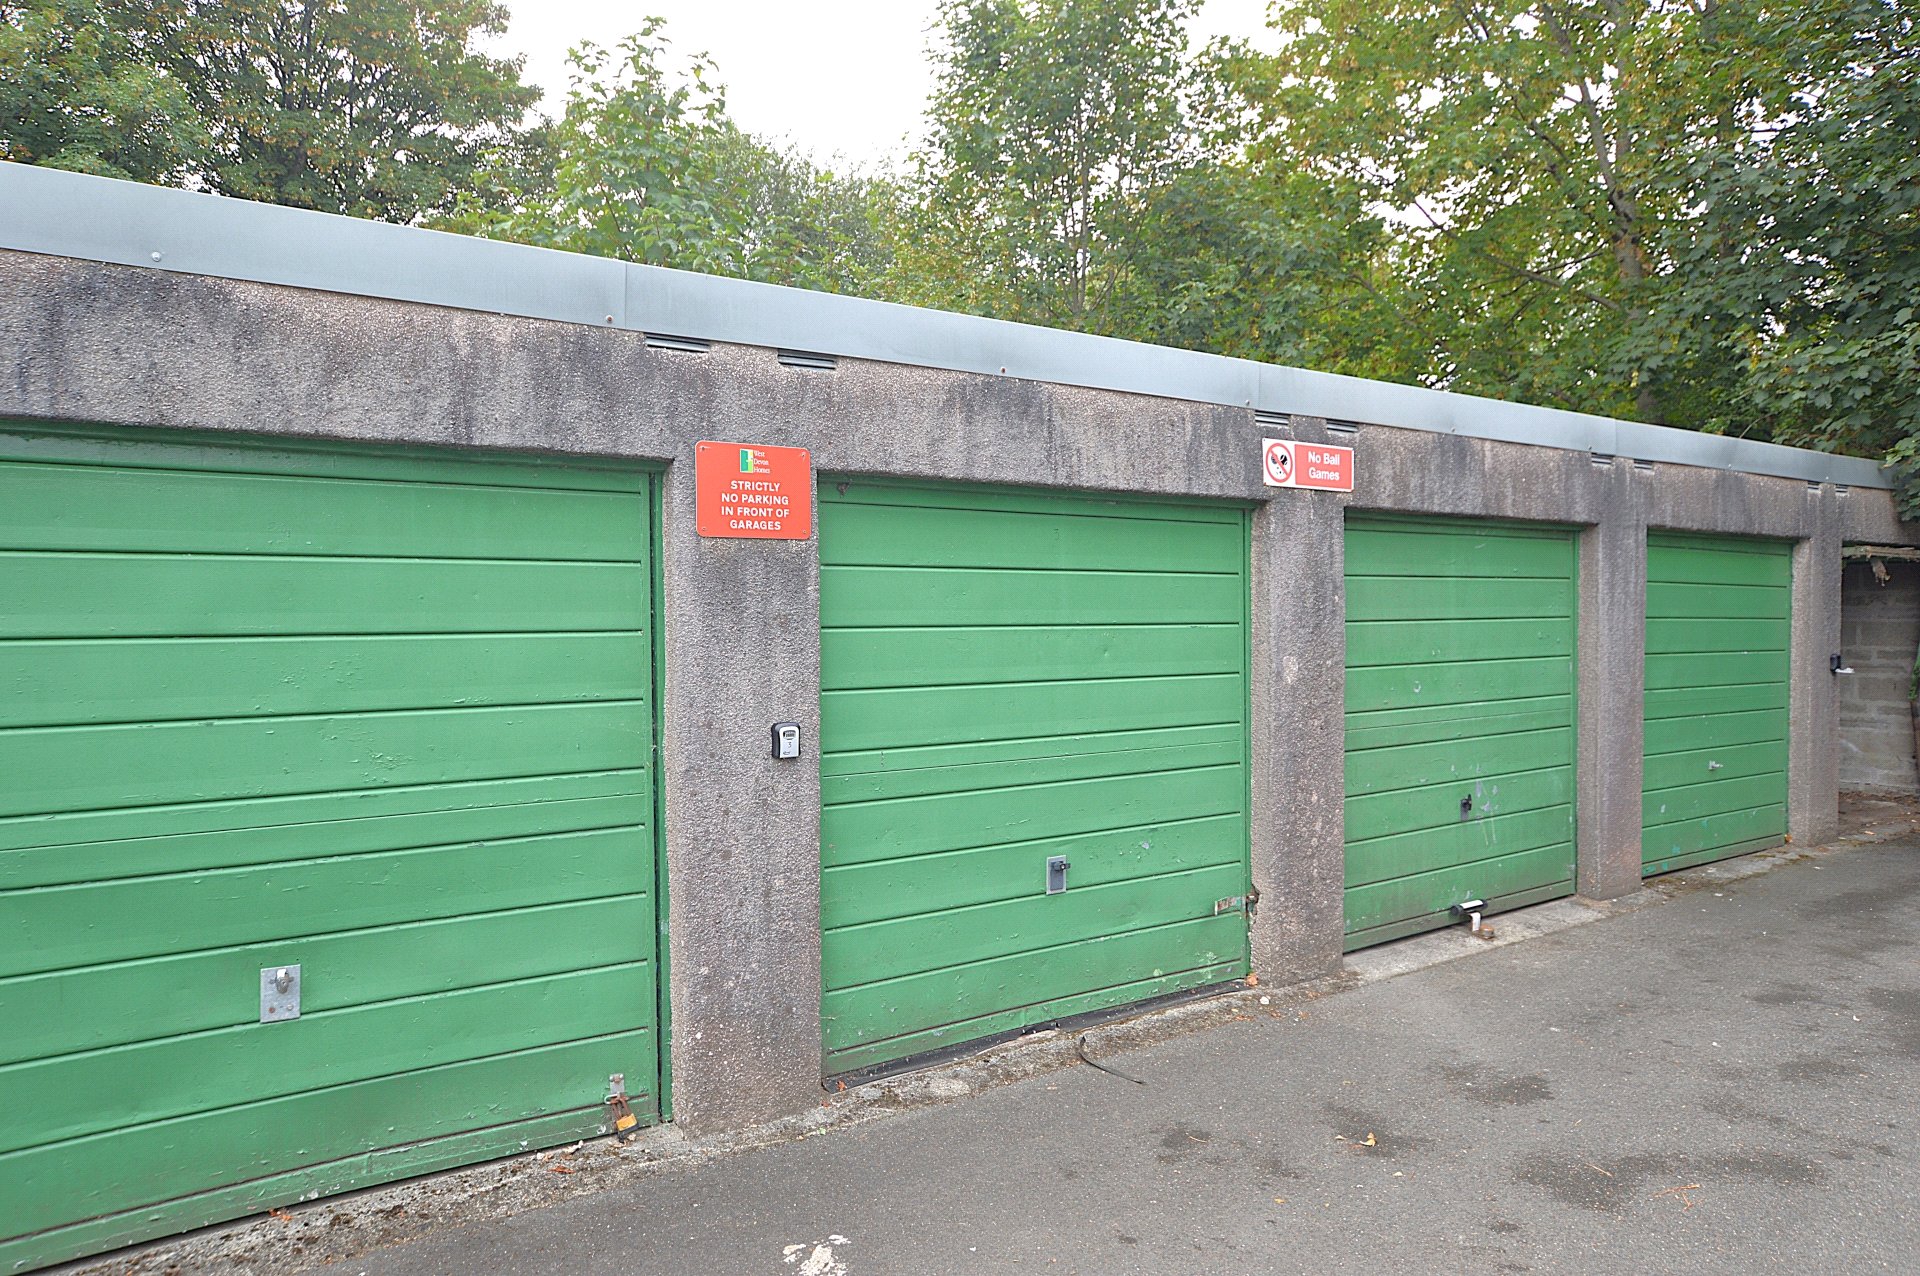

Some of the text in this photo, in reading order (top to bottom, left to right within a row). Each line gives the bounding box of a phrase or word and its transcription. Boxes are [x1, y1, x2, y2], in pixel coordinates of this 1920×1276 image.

[1308, 451, 1340, 466] No Ball
[1308, 467, 1340, 480] Games
[730, 480, 780, 492] STRICTLY
[721, 493, 789, 506] NO PARKING
[721, 506, 790, 518] IN FRONT OF
[729, 519, 781, 531] GARAGES
